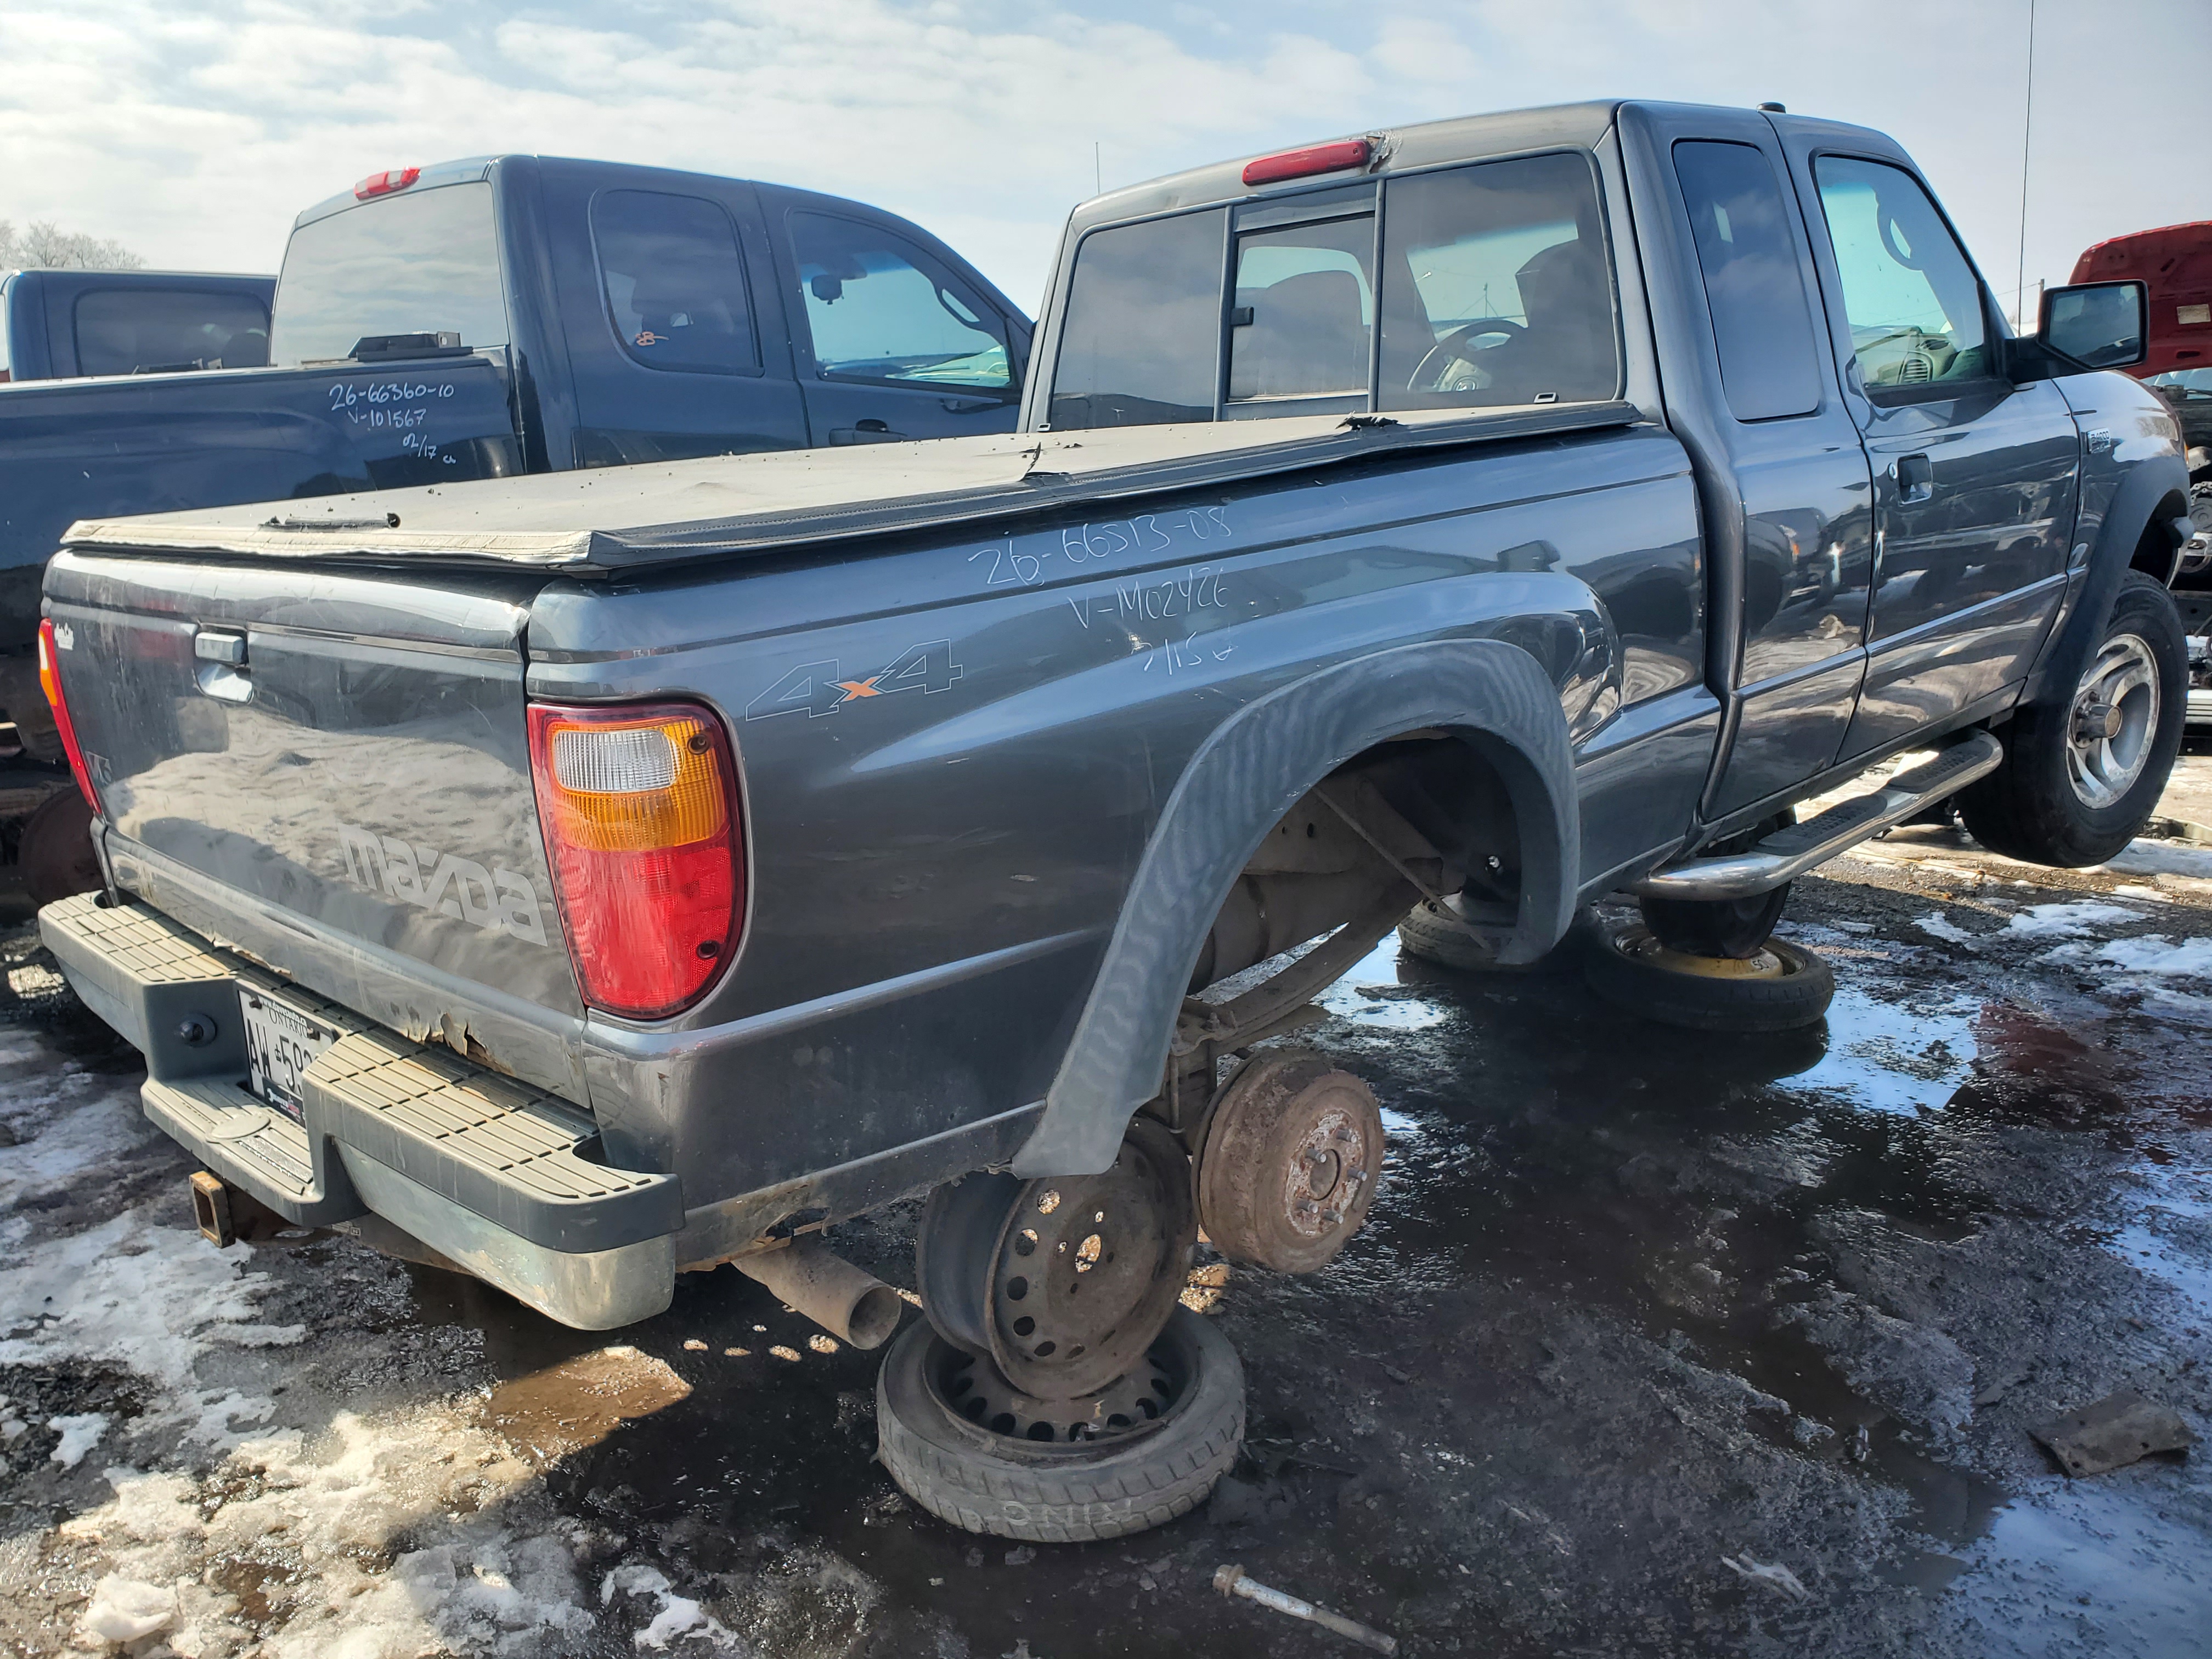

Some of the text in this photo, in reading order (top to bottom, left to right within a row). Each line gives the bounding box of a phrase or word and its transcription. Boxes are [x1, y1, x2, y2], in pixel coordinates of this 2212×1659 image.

[329, 383, 454, 410] 26-66360-10
[347, 407, 427, 428] V-101567
[247, 1018, 272, 1080] AW
